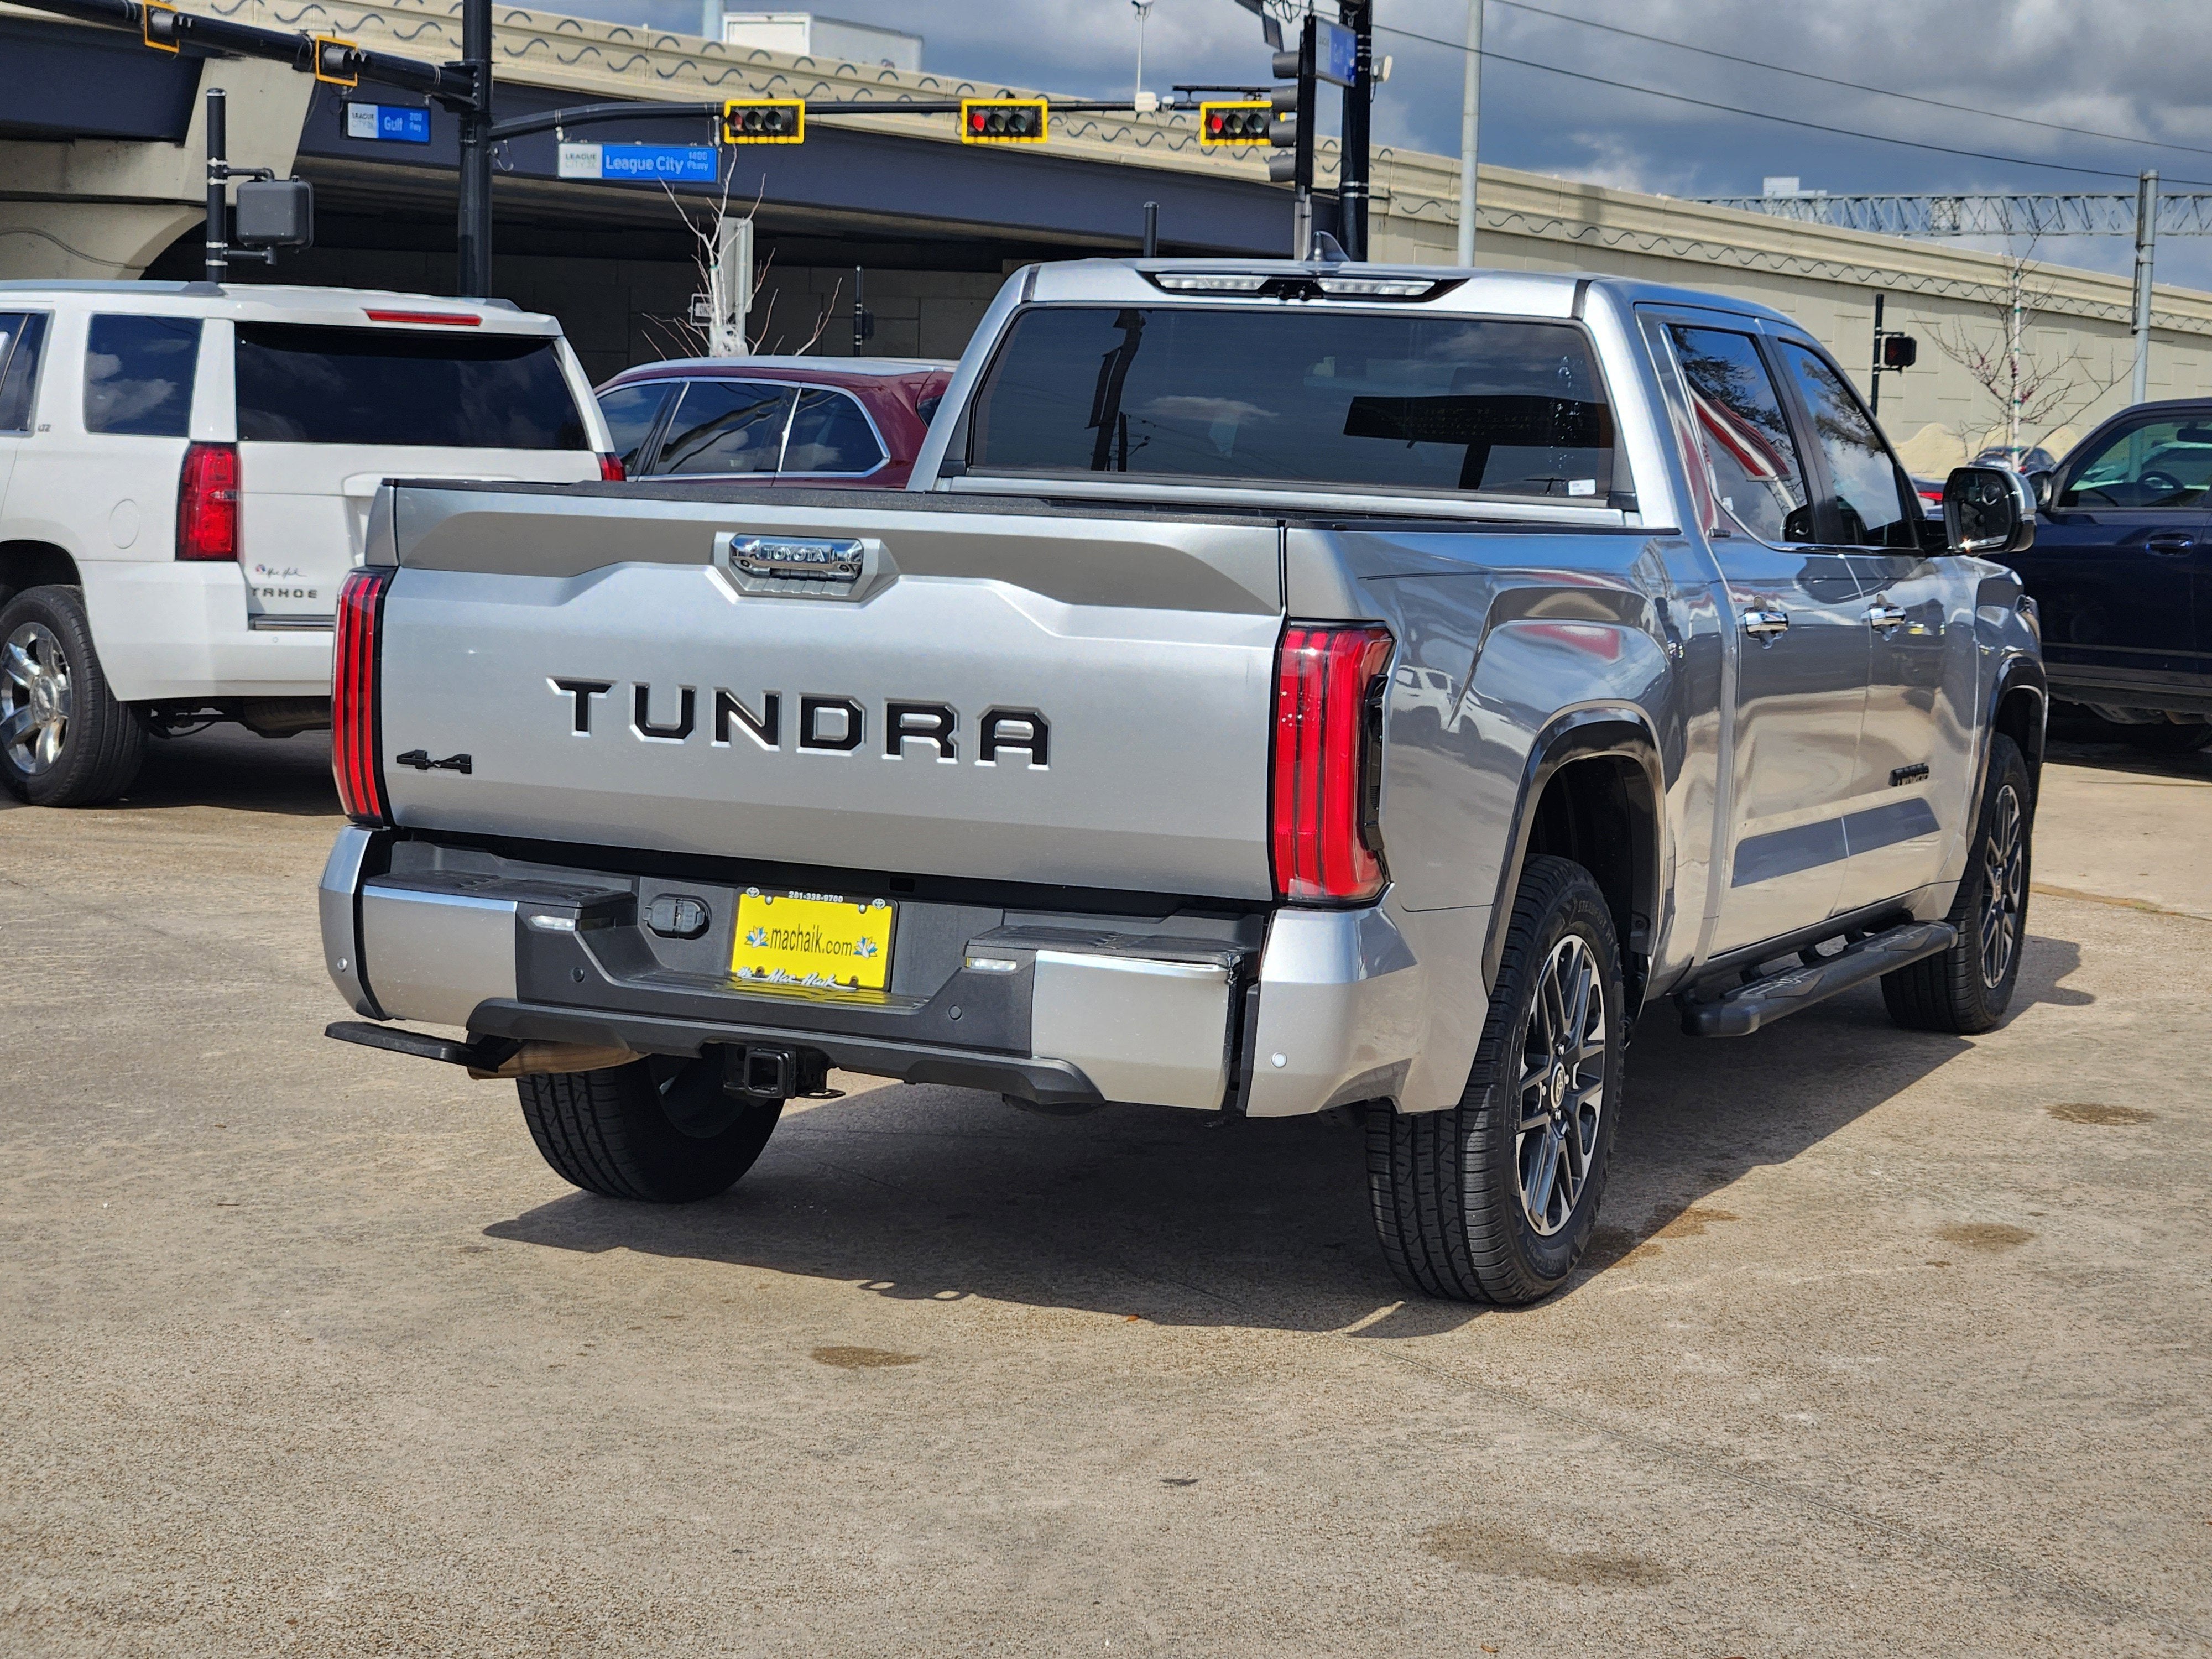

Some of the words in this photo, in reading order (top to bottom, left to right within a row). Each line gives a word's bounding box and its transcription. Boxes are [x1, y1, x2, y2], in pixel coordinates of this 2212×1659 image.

[383, 116, 403, 131] Gulf
[605, 155, 654, 174] League
[656, 156, 684, 174] City
[763, 545, 826, 563] TOYOTA
[251, 586, 318, 599] TAHOE
[546, 676, 1052, 771] TUNDRA
[770, 923, 853, 957] machaik.com
[767, 968, 800, 983] Mac
